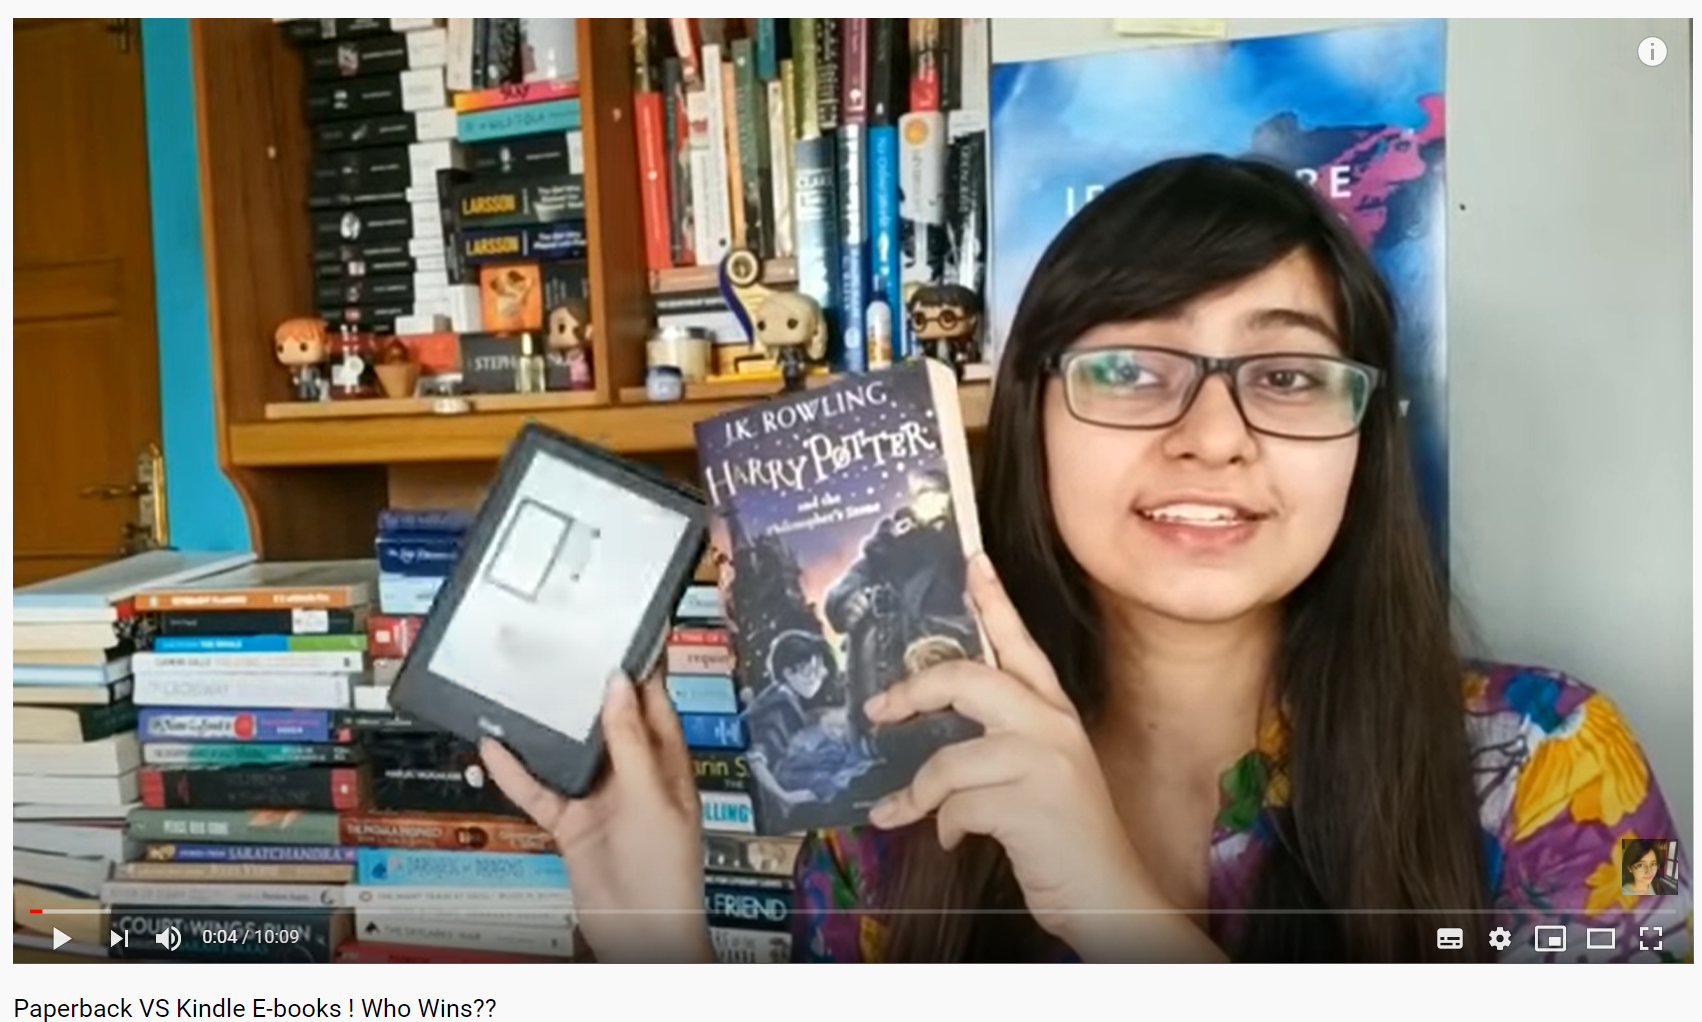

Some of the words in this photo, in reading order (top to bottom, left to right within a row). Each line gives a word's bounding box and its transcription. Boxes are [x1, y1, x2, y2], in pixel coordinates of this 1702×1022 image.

[462, 193, 516, 216] LARSSON
[465, 235, 519, 257] LARSSON
[762, 381, 888, 433] ROWLING
[705, 456, 808, 506] HARRY
[803, 421, 937, 484] POTTER
[797, 495, 818, 512] and
[821, 491, 842, 505] the
[704, 801, 752, 824] LLING
[227, 847, 342, 861] SARATCHANDRA
[714, 892, 788, 922] FRIEND
[119, 915, 183, 935] COURT
